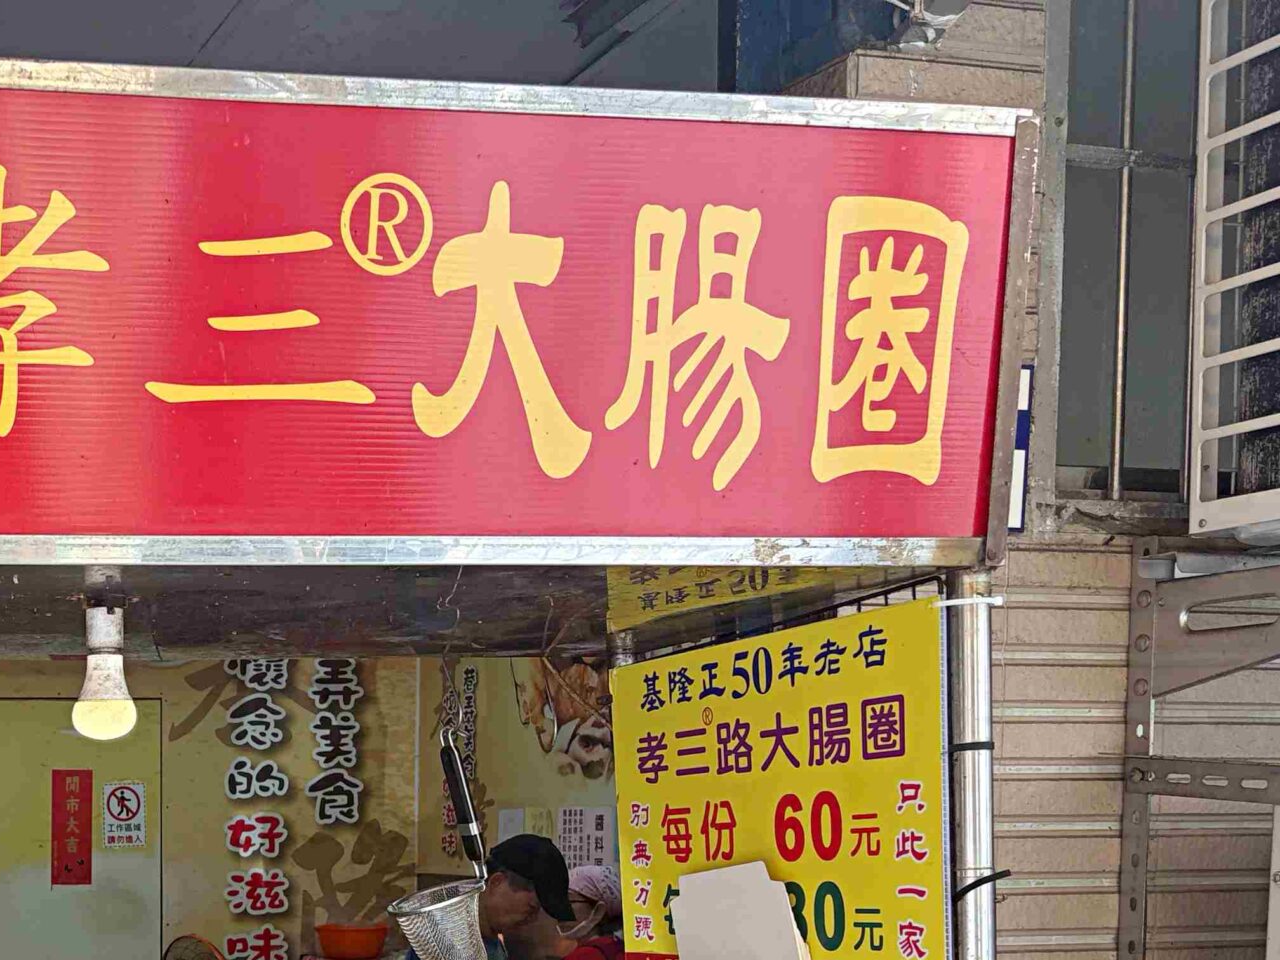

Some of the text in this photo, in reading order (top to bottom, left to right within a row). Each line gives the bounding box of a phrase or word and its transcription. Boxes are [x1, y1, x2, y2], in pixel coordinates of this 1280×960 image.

[641, 625, 889, 712] 基隆正50年老店
[637, 694, 906, 784] 孝三路大腸圈
[662, 801, 736, 863] 每份
[774, 790, 881, 863] 60元
[896, 782, 929, 958] 只此一家
